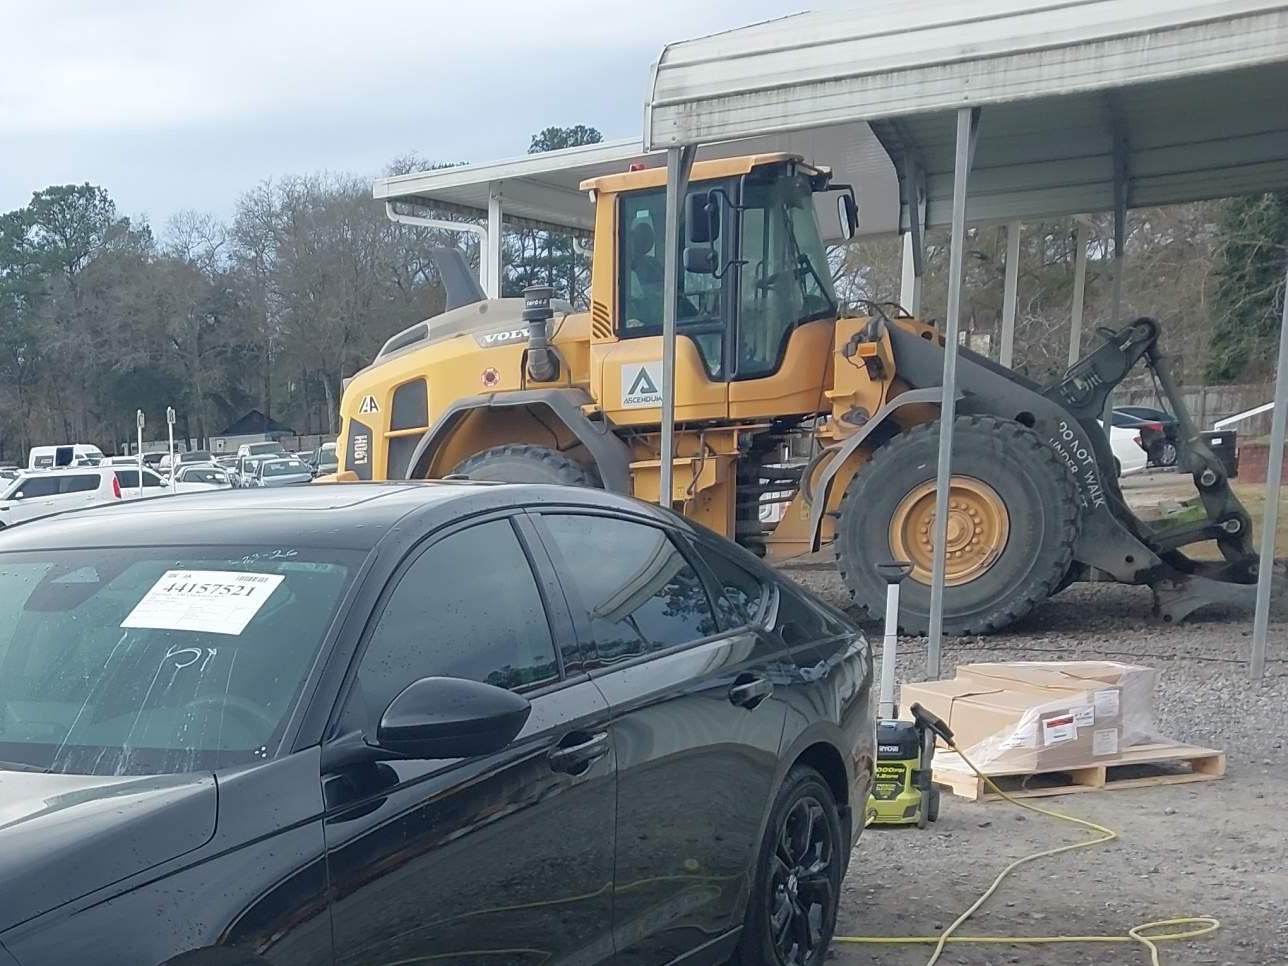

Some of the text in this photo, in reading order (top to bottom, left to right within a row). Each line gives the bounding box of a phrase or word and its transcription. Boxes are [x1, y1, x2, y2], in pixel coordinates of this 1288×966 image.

[1059, 421, 1074, 441] DO
[1069, 439, 1094, 465] NOT
[1084, 470, 1106, 508] WALK
[163, 582, 257, 597] 44157521
